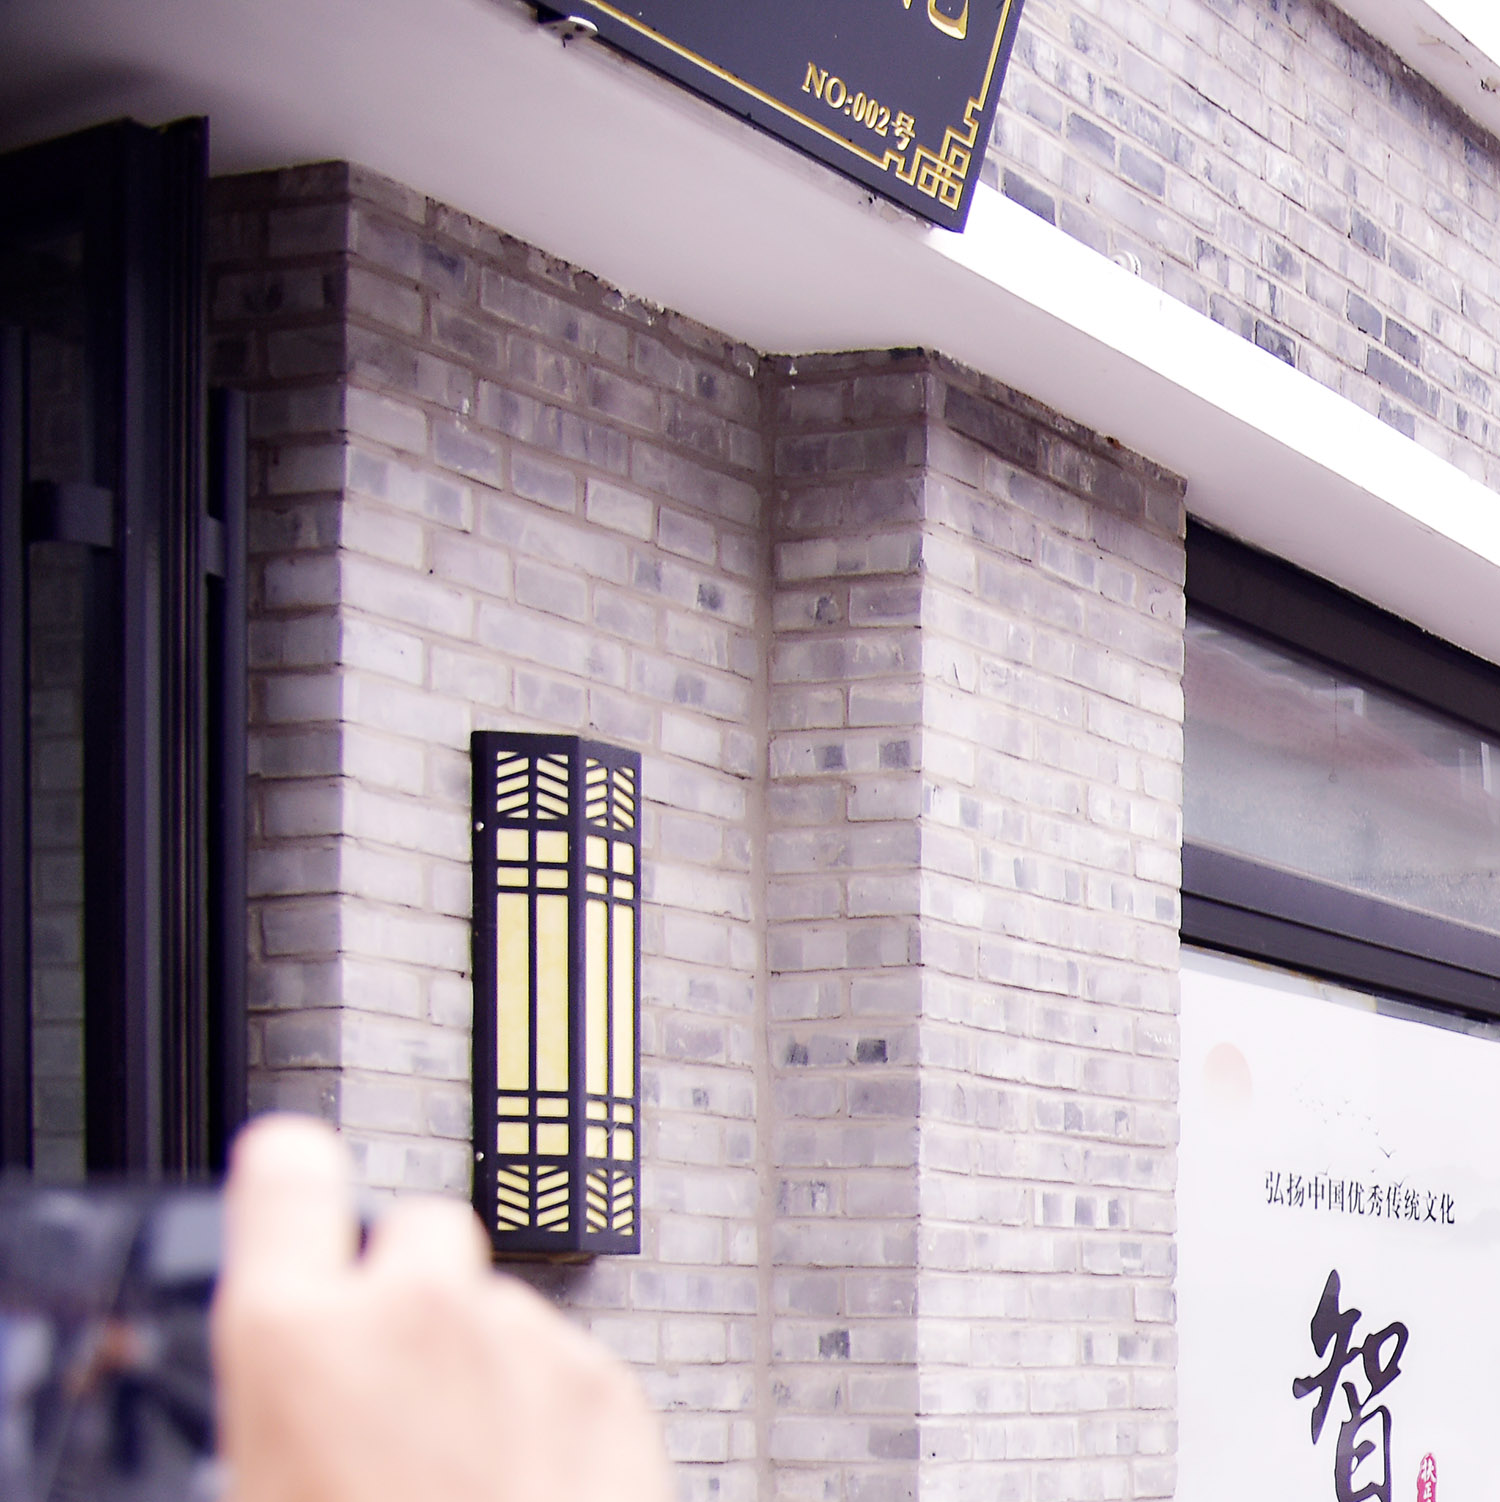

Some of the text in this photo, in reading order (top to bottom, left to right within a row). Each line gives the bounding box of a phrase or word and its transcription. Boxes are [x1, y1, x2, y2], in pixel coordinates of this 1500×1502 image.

[802, 61, 915, 150] NO:002号
[1265, 1171, 1456, 1225] 弘扬中国优秀传统文化
